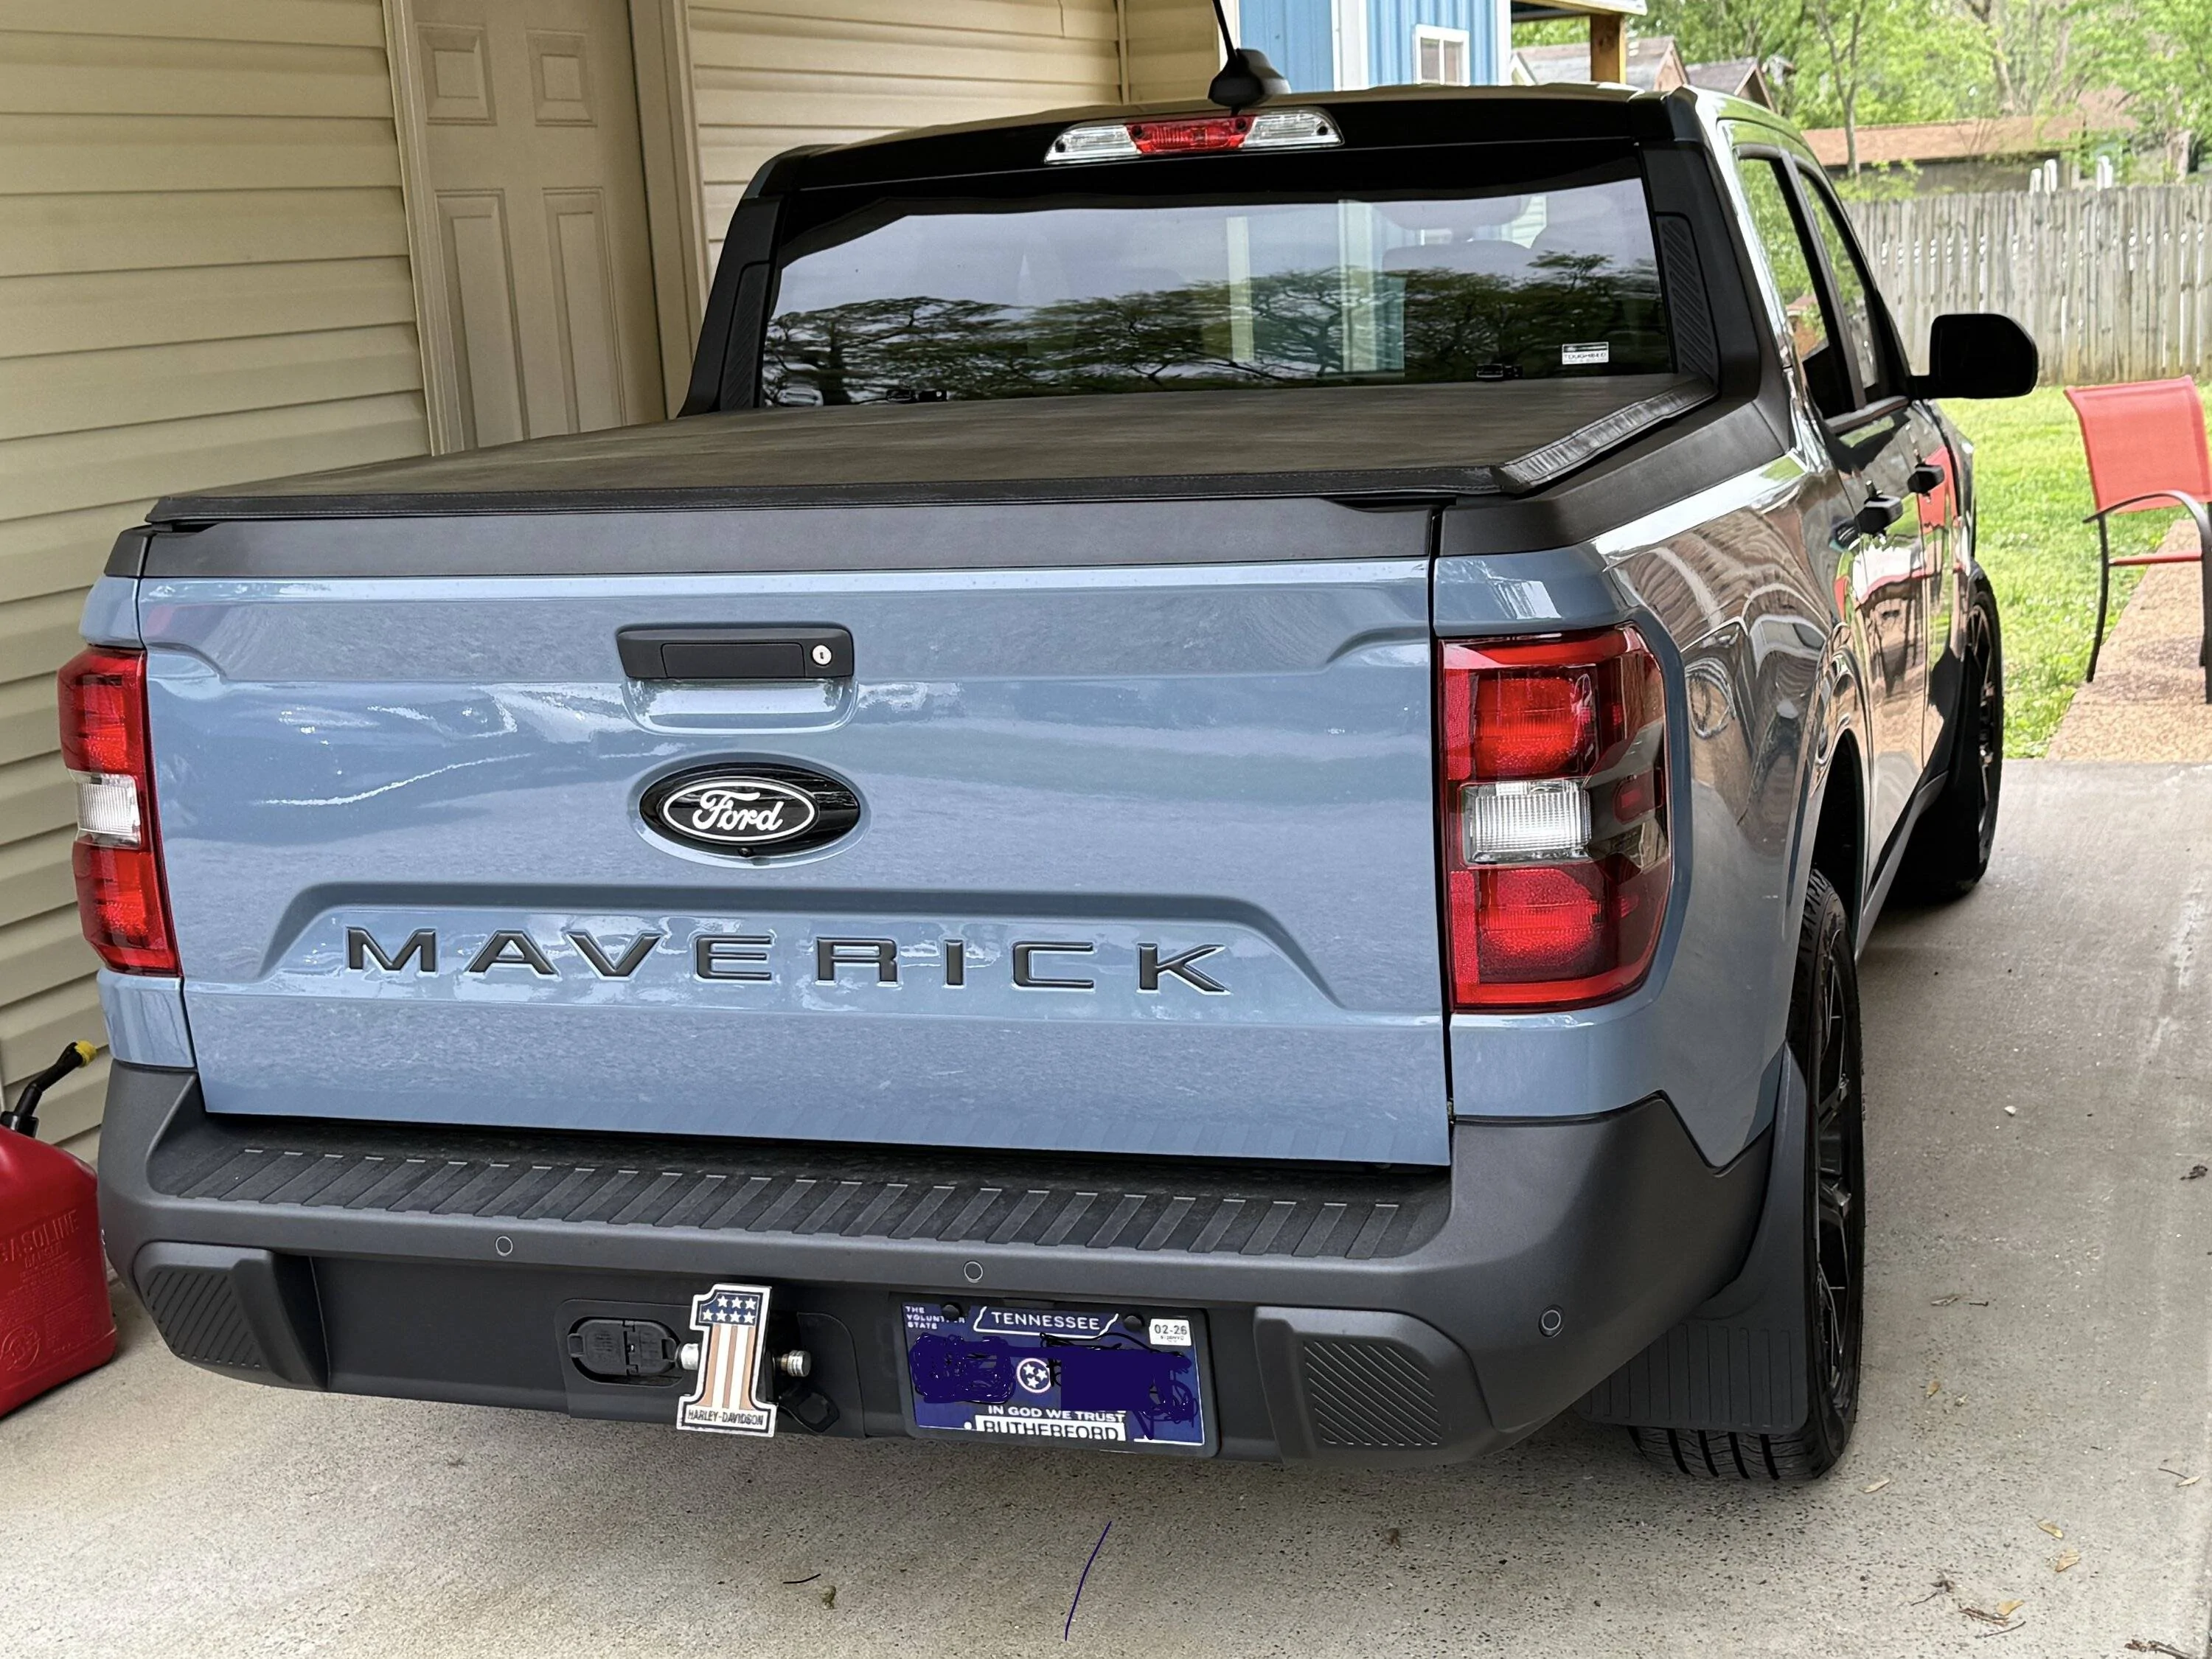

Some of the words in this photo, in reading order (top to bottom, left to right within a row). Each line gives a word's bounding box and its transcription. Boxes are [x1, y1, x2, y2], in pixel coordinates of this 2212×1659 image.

[692, 789, 785, 832] Ford
[346, 926, 1231, 995] MAVERICK
[905, 1306, 925, 1314] THE
[906, 1314, 965, 1324] VOLUNTR
[907, 1321, 938, 1329] STATE
[991, 1312, 1100, 1330] TENNESSEE
[687, 1408, 764, 1426] HARLEY-DAVIDSON
[987, 1405, 1004, 1415] IN
[1007, 1406, 1043, 1418] GOD
[1046, 1409, 1072, 1420] WE
[1074, 1411, 1126, 1423] TRUST
[983, 1420, 1119, 1440] RUTHERFORD
